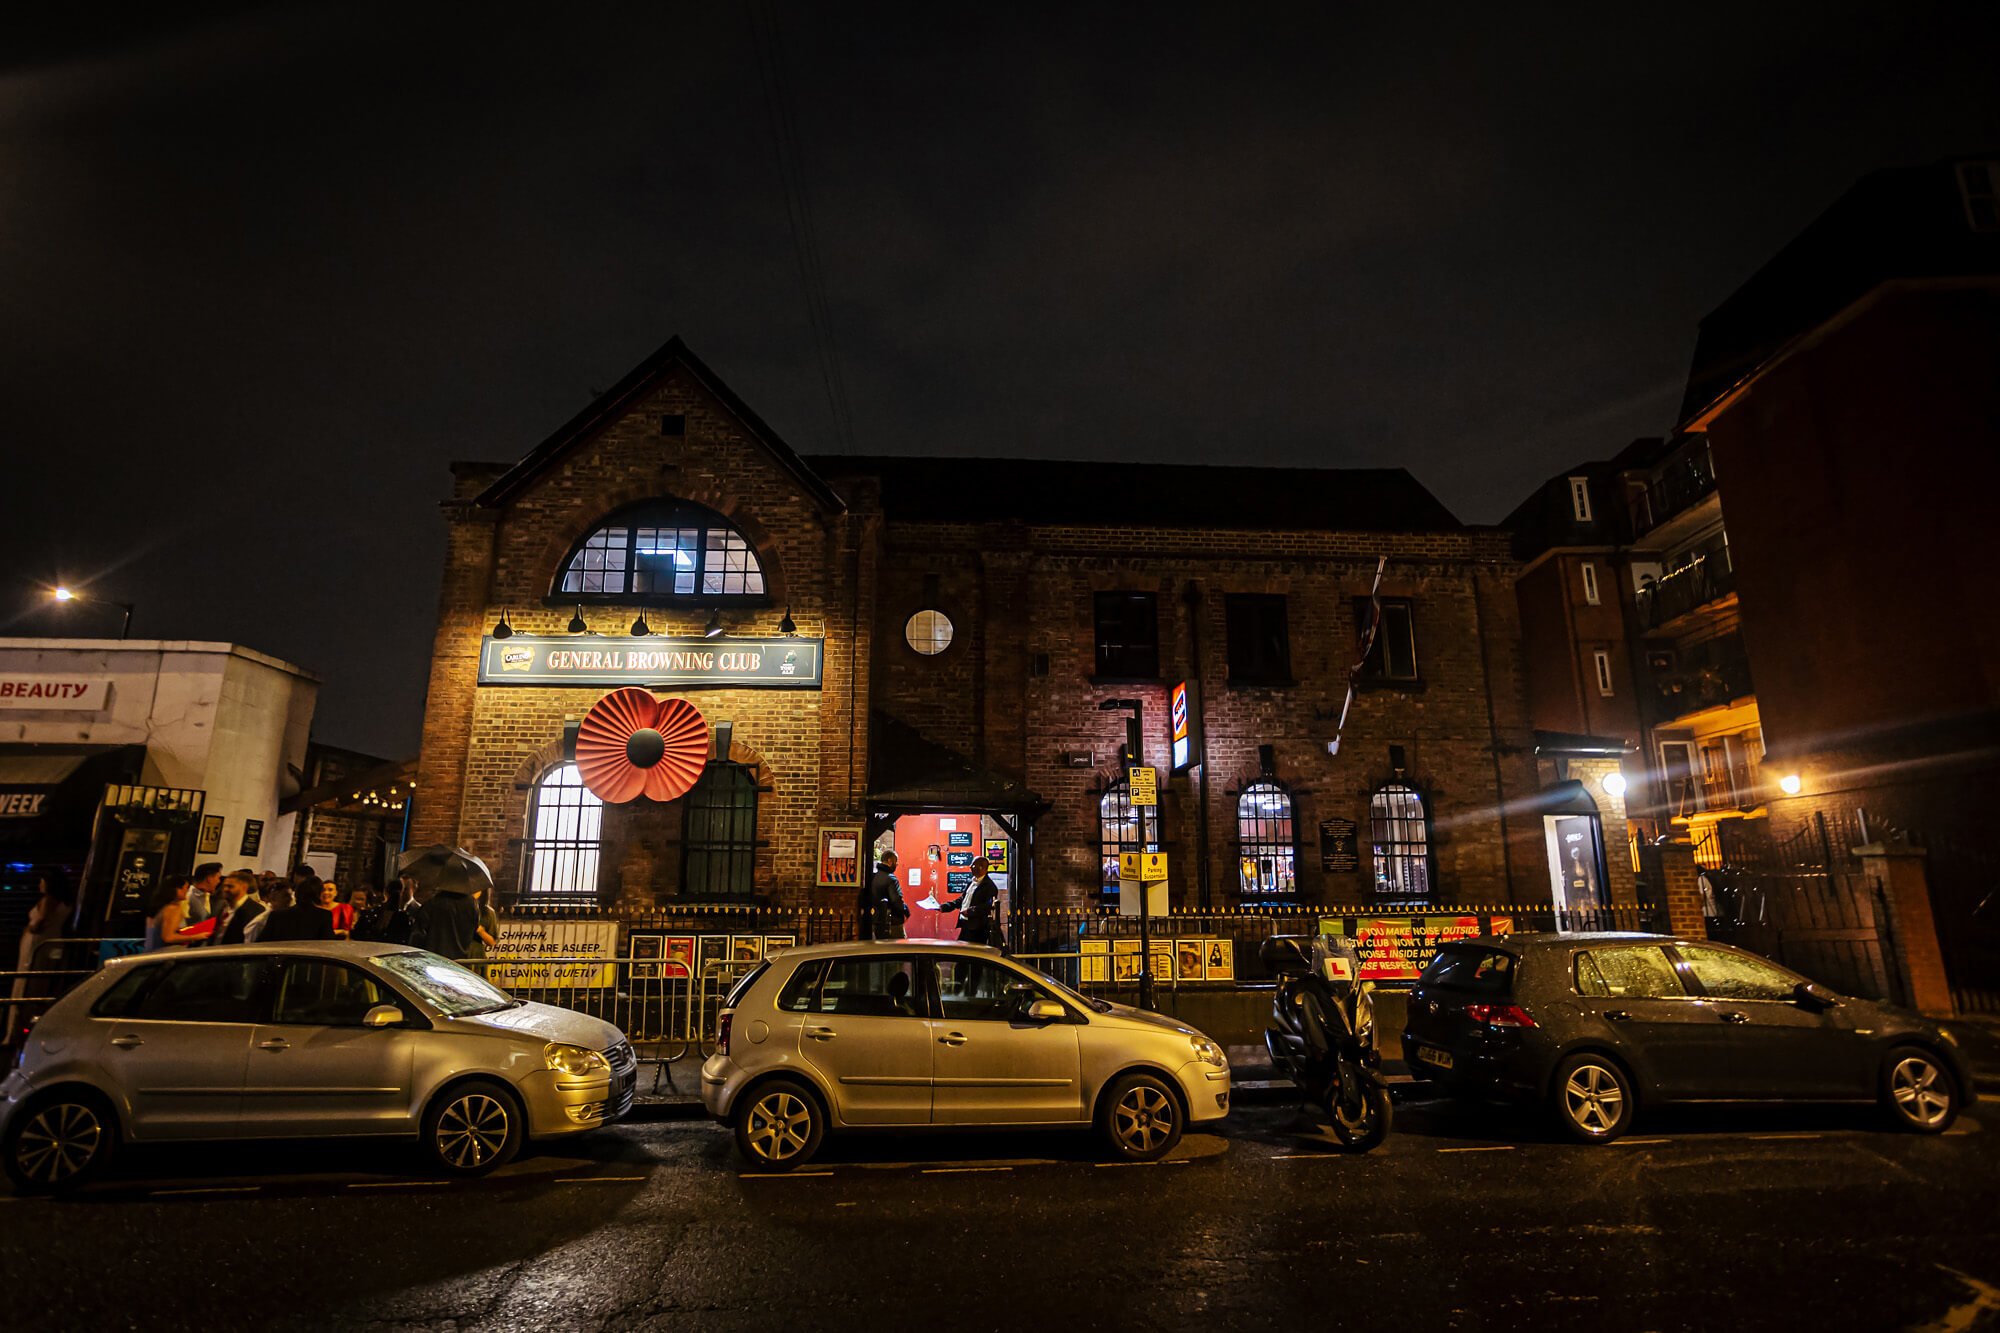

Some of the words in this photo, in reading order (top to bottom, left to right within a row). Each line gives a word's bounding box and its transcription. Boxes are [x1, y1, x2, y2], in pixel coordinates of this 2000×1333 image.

[547, 650, 623, 669] GENERAL
[627, 651, 714, 671] BROWNING
[718, 653, 761, 671] CLUB
[0, 682, 88, 698] BEAUTY
[205, 826, 219, 842] 15
[1356, 927, 1365, 936] IF
[1366, 927, 1385, 936] YOU
[1386, 927, 1411, 936] MAKE
[1413, 926, 1440, 936] NOISE
[1442, 926, 1481, 937] OUTSIDE,
[484, 943, 537, 952] GHBOURS
[538, 943, 559, 952] ARE
[1366, 939, 1389, 948] CLUB
[1392, 938, 1422, 948] WON'T
[1424, 938, 1436, 947] BE
[1358, 949, 1387, 959] NOISE
[1389, 949, 1419, 959] INSIDE
[1331, 962, 1346, 975] L
[1358, 960, 1377, 970] ASE
[1379, 960, 1417, 970] RESPECT
[490, 969, 502, 978] BY
[504, 969, 550, 978] LEAVING
[554, 968, 597, 978] QUIETLY
